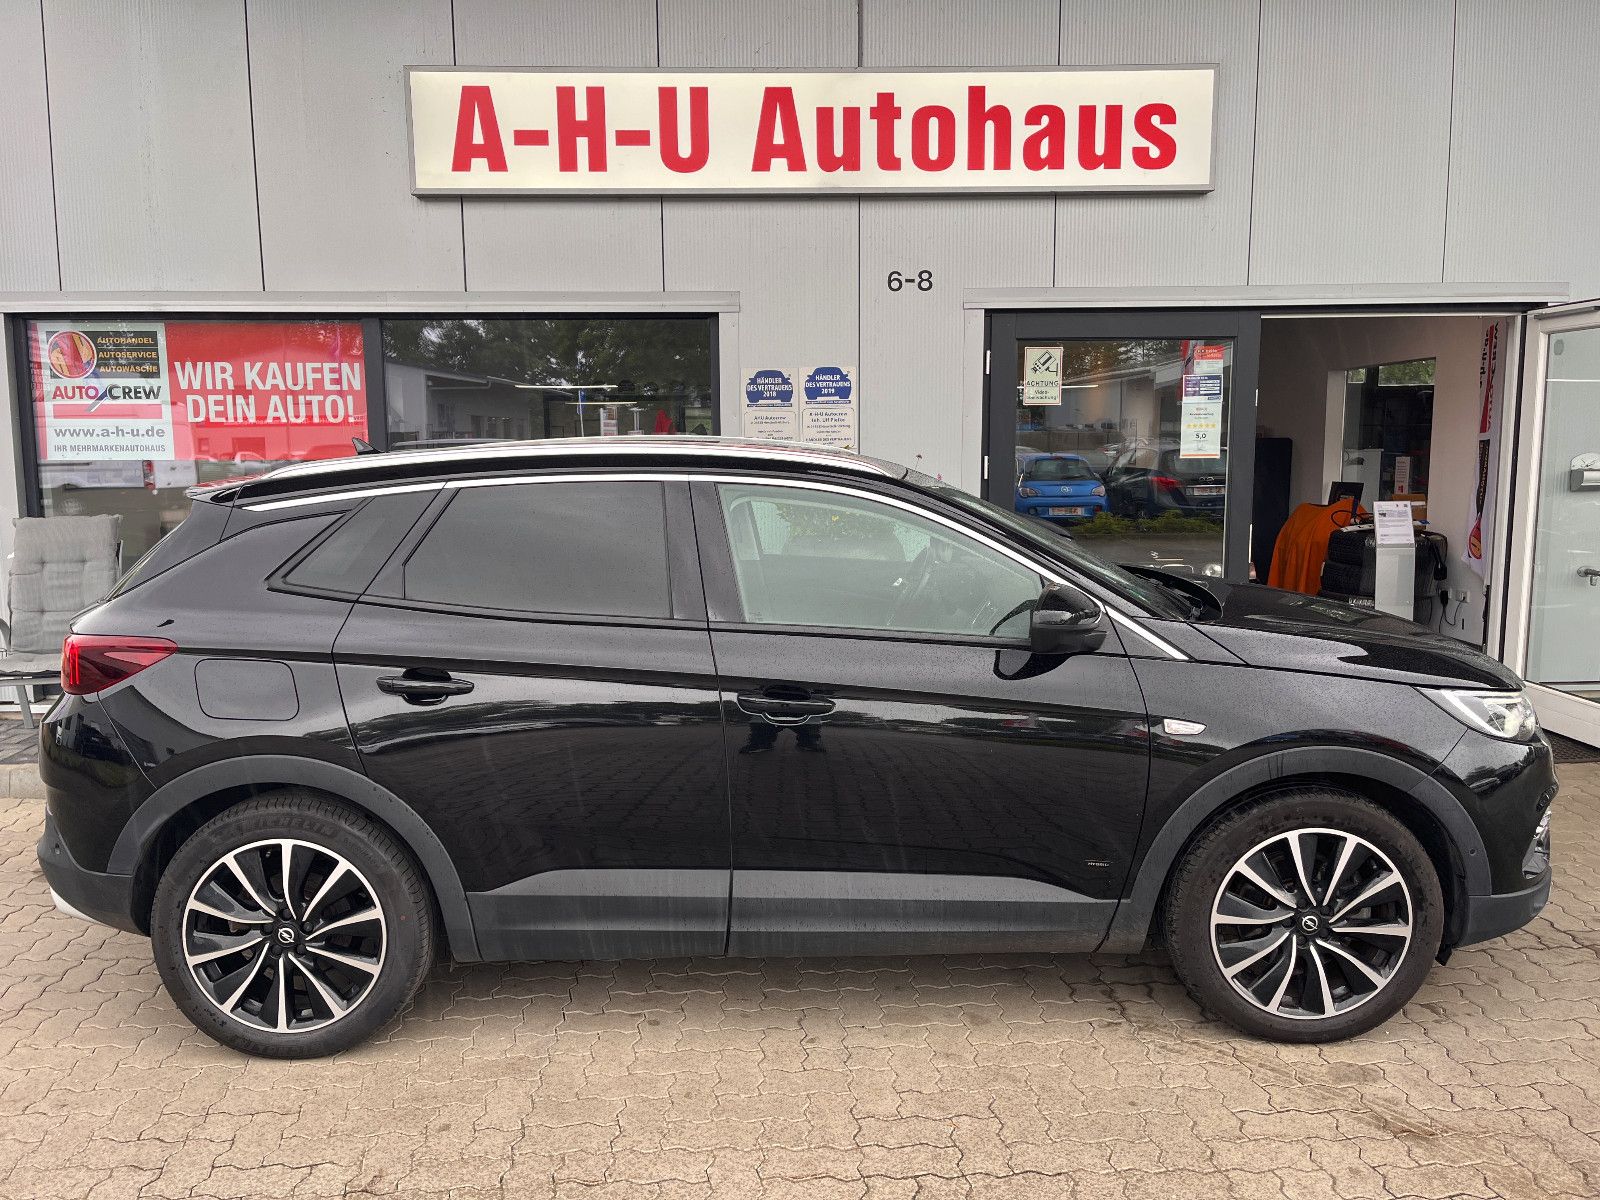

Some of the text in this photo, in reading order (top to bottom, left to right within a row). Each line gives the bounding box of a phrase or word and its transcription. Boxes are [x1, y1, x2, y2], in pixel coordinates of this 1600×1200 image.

[451, 85, 1178, 173] A-H-U Autohaus
[886, 270, 934, 291] 6-8
[174, 361, 361, 391] WIR KAUFEN
[52, 384, 162, 400] AUTO CREW
[186, 394, 355, 423] DEIN AUTO!
[54, 426, 165, 438] www.a-h-u.de
